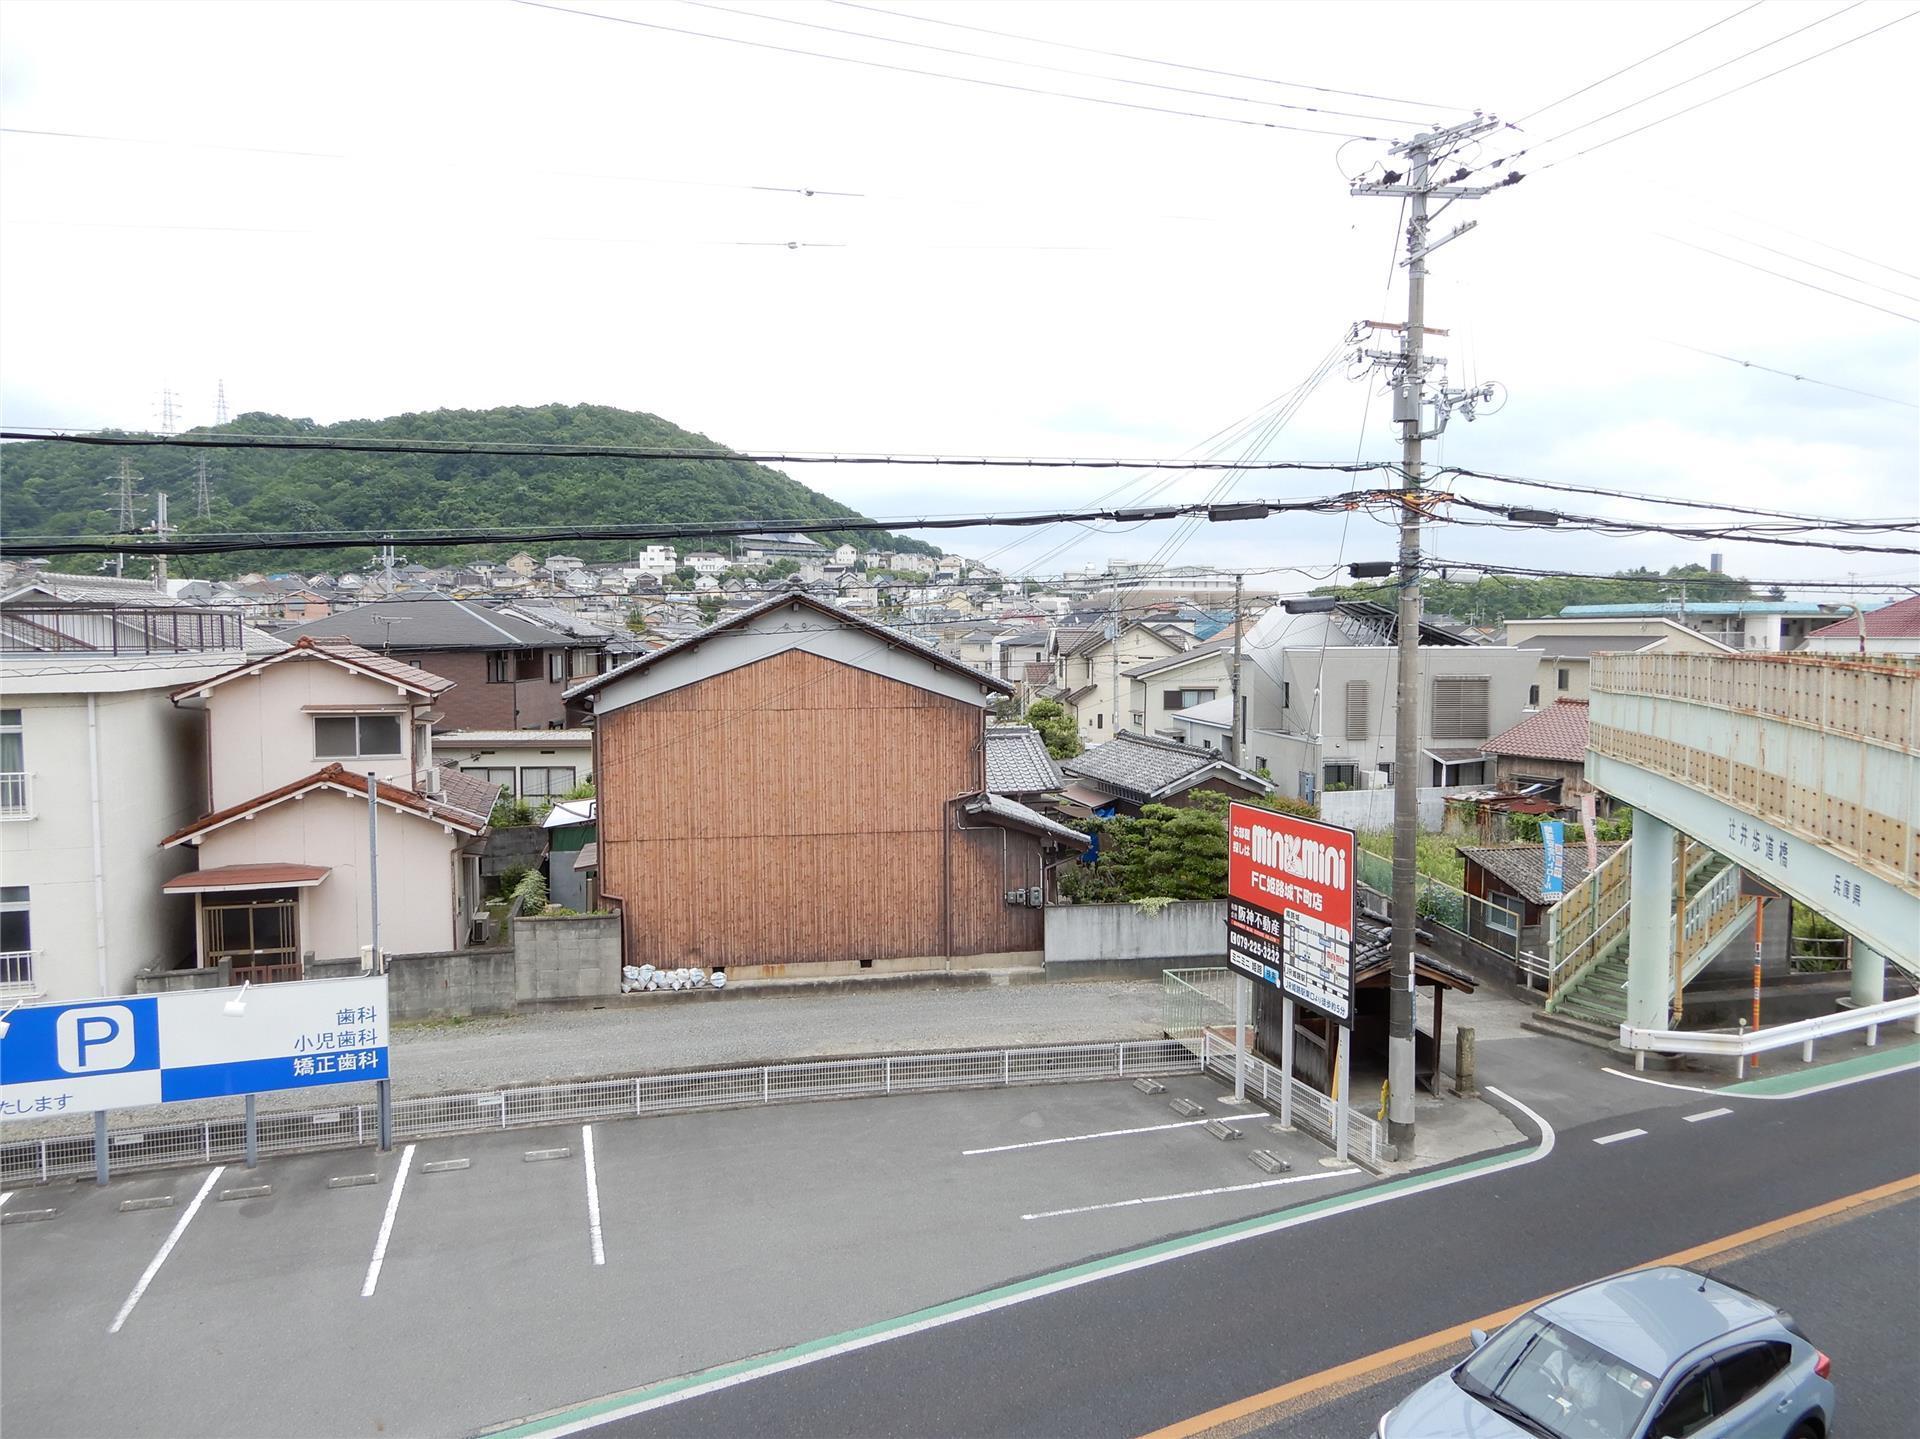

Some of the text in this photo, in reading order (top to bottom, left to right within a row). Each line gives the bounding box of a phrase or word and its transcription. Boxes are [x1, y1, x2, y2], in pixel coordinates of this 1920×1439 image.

[1728, 816, 1788, 869] 辻井歩道橋
[1251, 870, 1323, 912] FC姫路城下町店
[1833, 874, 1861, 907] 兵庫県
[1238, 906, 1280, 937] 阪神不動産
[1236, 934, 1280, 964] 079-225-3232
[336, 1006, 377, 1026] 歯科
[76, 1016, 120, 1067] P
[293, 1028, 378, 1053] 小児歯科
[293, 1050, 379, 1077] 矯正歯科
